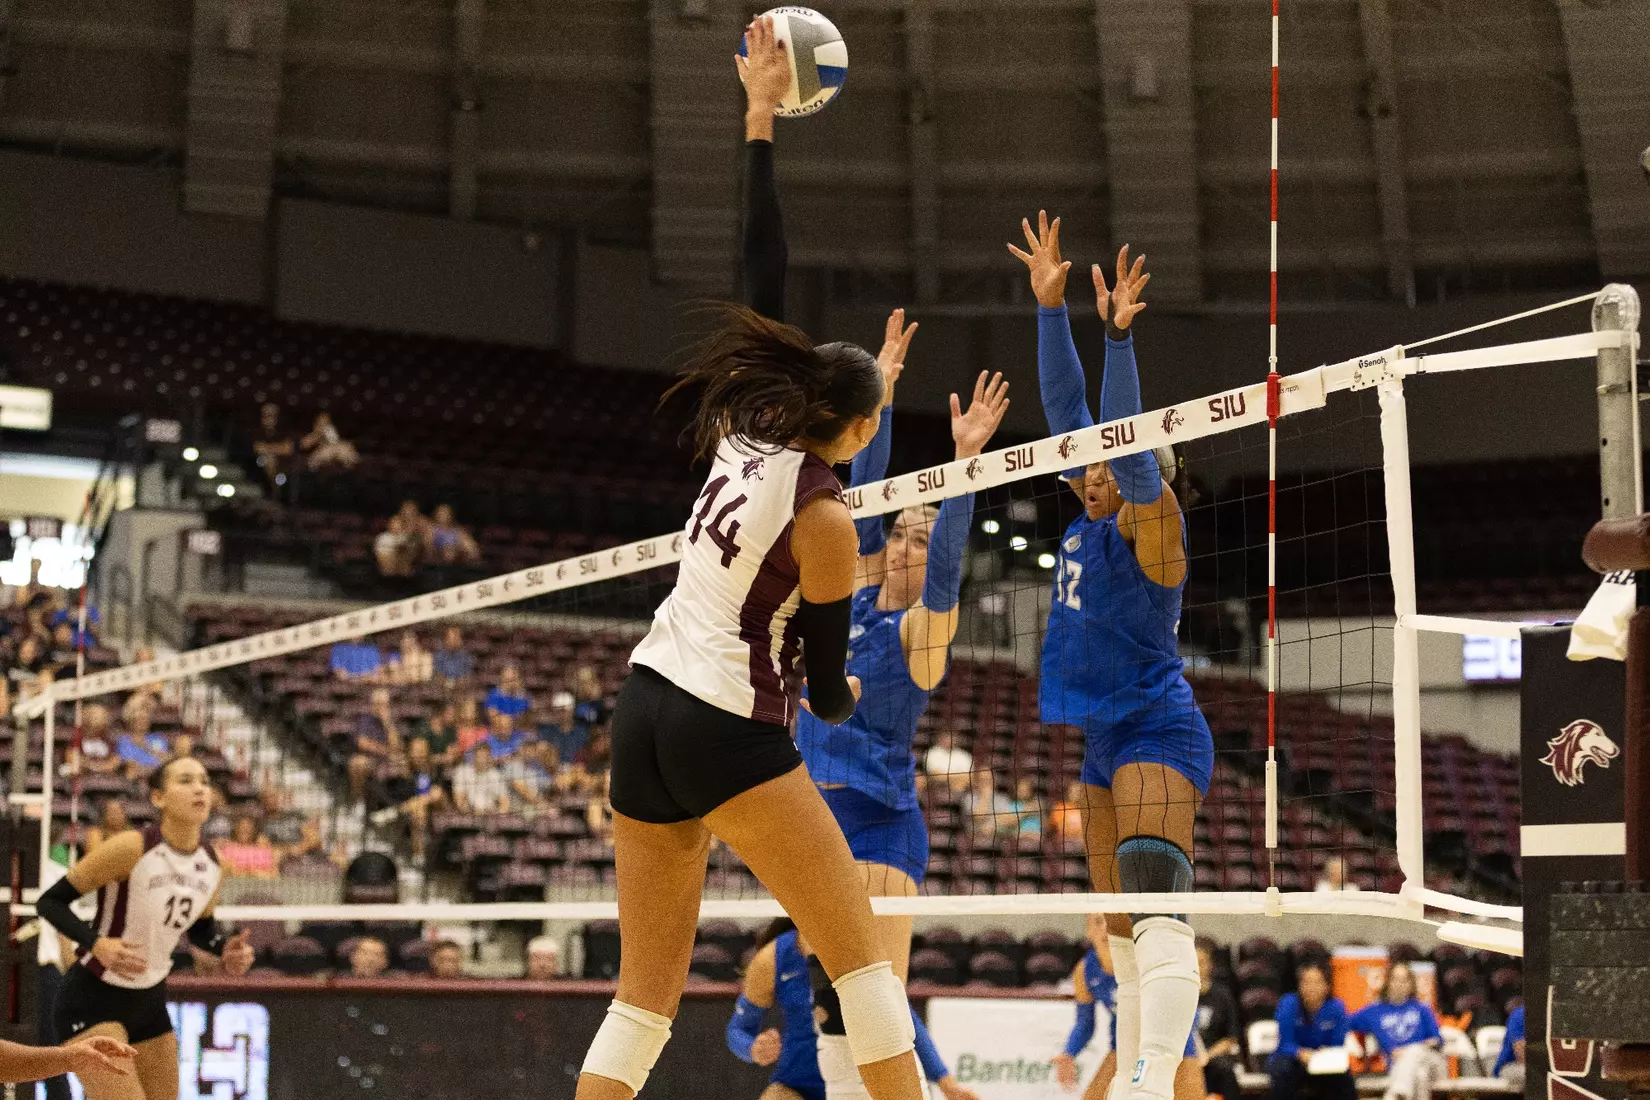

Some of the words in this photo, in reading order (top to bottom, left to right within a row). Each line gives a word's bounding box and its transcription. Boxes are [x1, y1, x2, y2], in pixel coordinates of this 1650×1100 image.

[1364, 356, 1386, 368] Senoh
[918, 468, 945, 493] SIU
[1004, 446, 1034, 472] SIU
[1100, 421, 1136, 450] SIU
[1208, 392, 1246, 423] SIU
[688, 474, 748, 570] 14
[580, 556, 598, 575] SIU
[636, 541, 656, 561] SIU
[163, 895, 194, 929] 13
